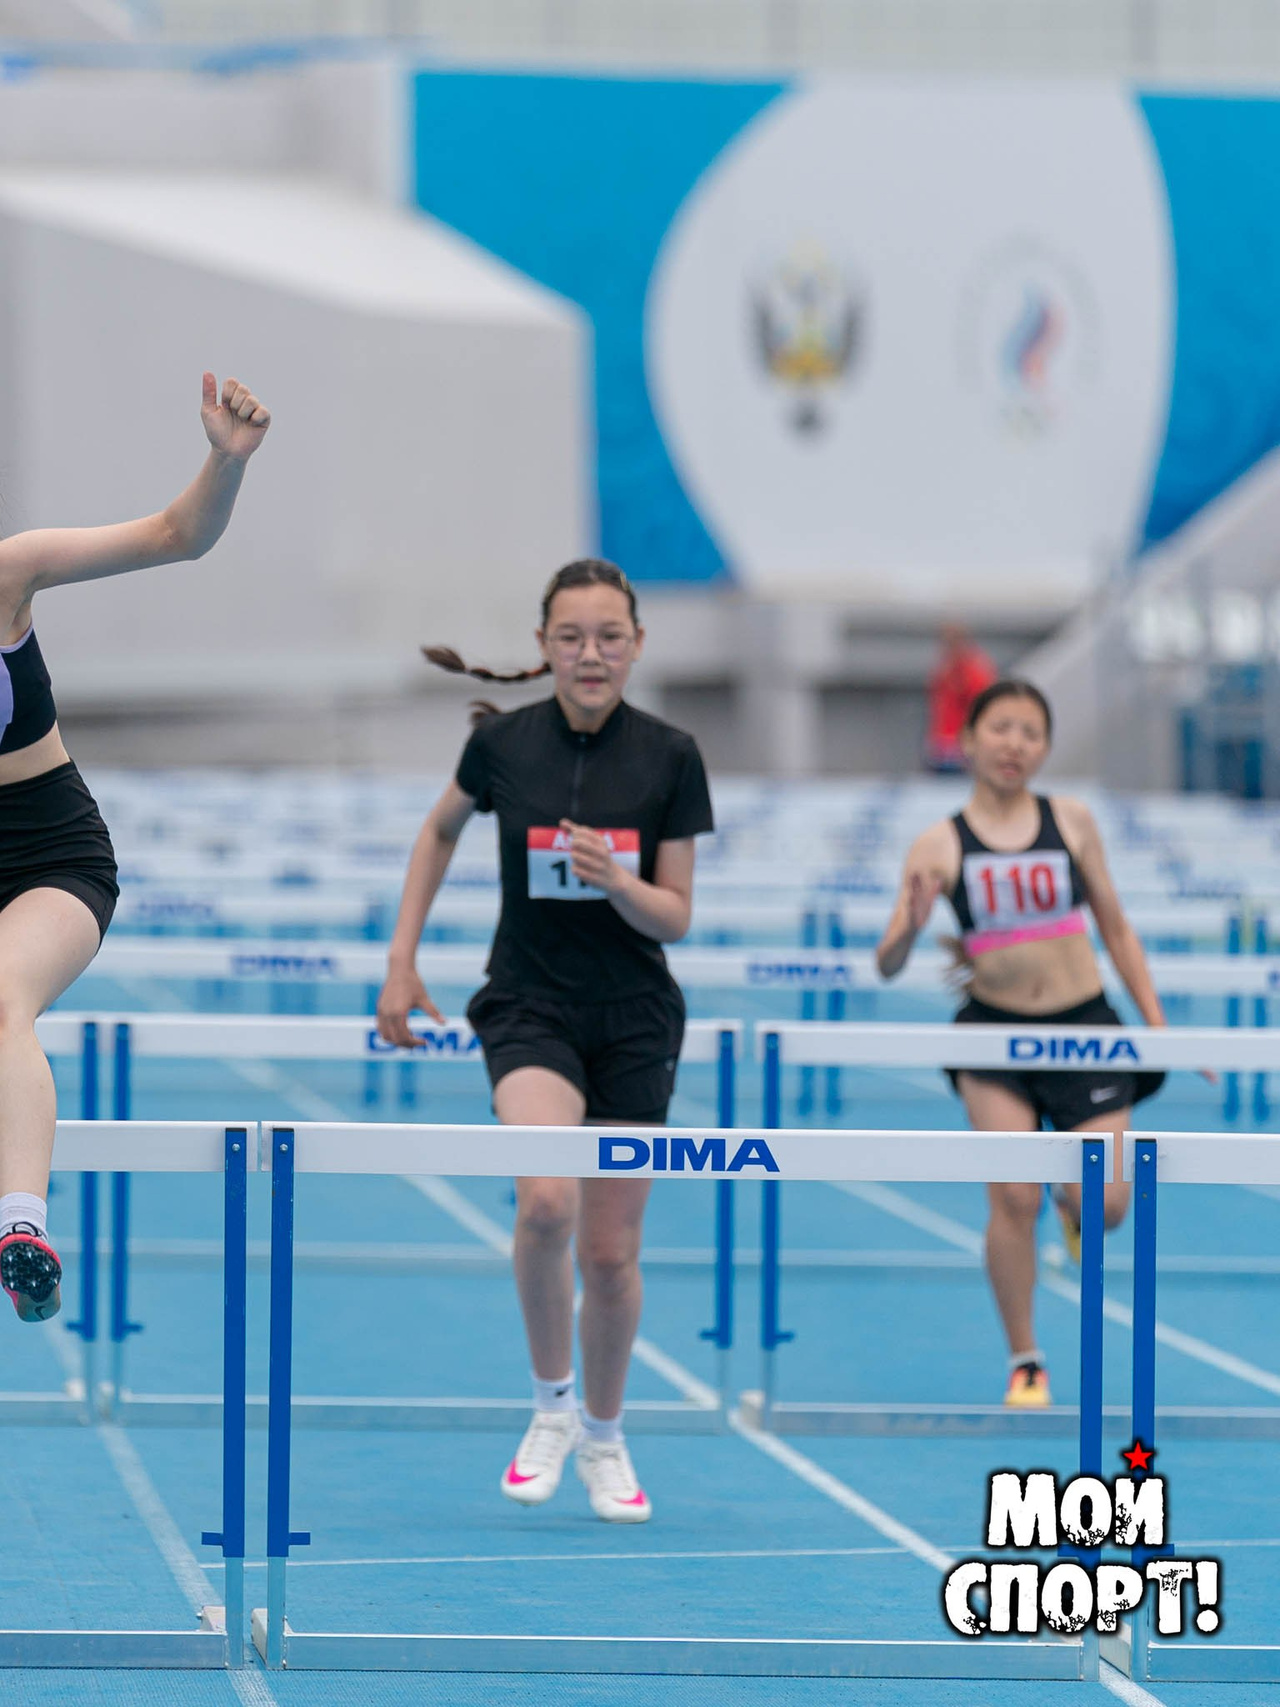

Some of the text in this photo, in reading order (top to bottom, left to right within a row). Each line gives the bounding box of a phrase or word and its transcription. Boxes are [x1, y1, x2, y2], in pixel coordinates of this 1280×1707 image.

[552, 832, 616, 851] AA
[979, 862, 1057, 916] 110
[1009, 1037, 1140, 1062] DIMA
[598, 1137, 780, 1172] DIMA
